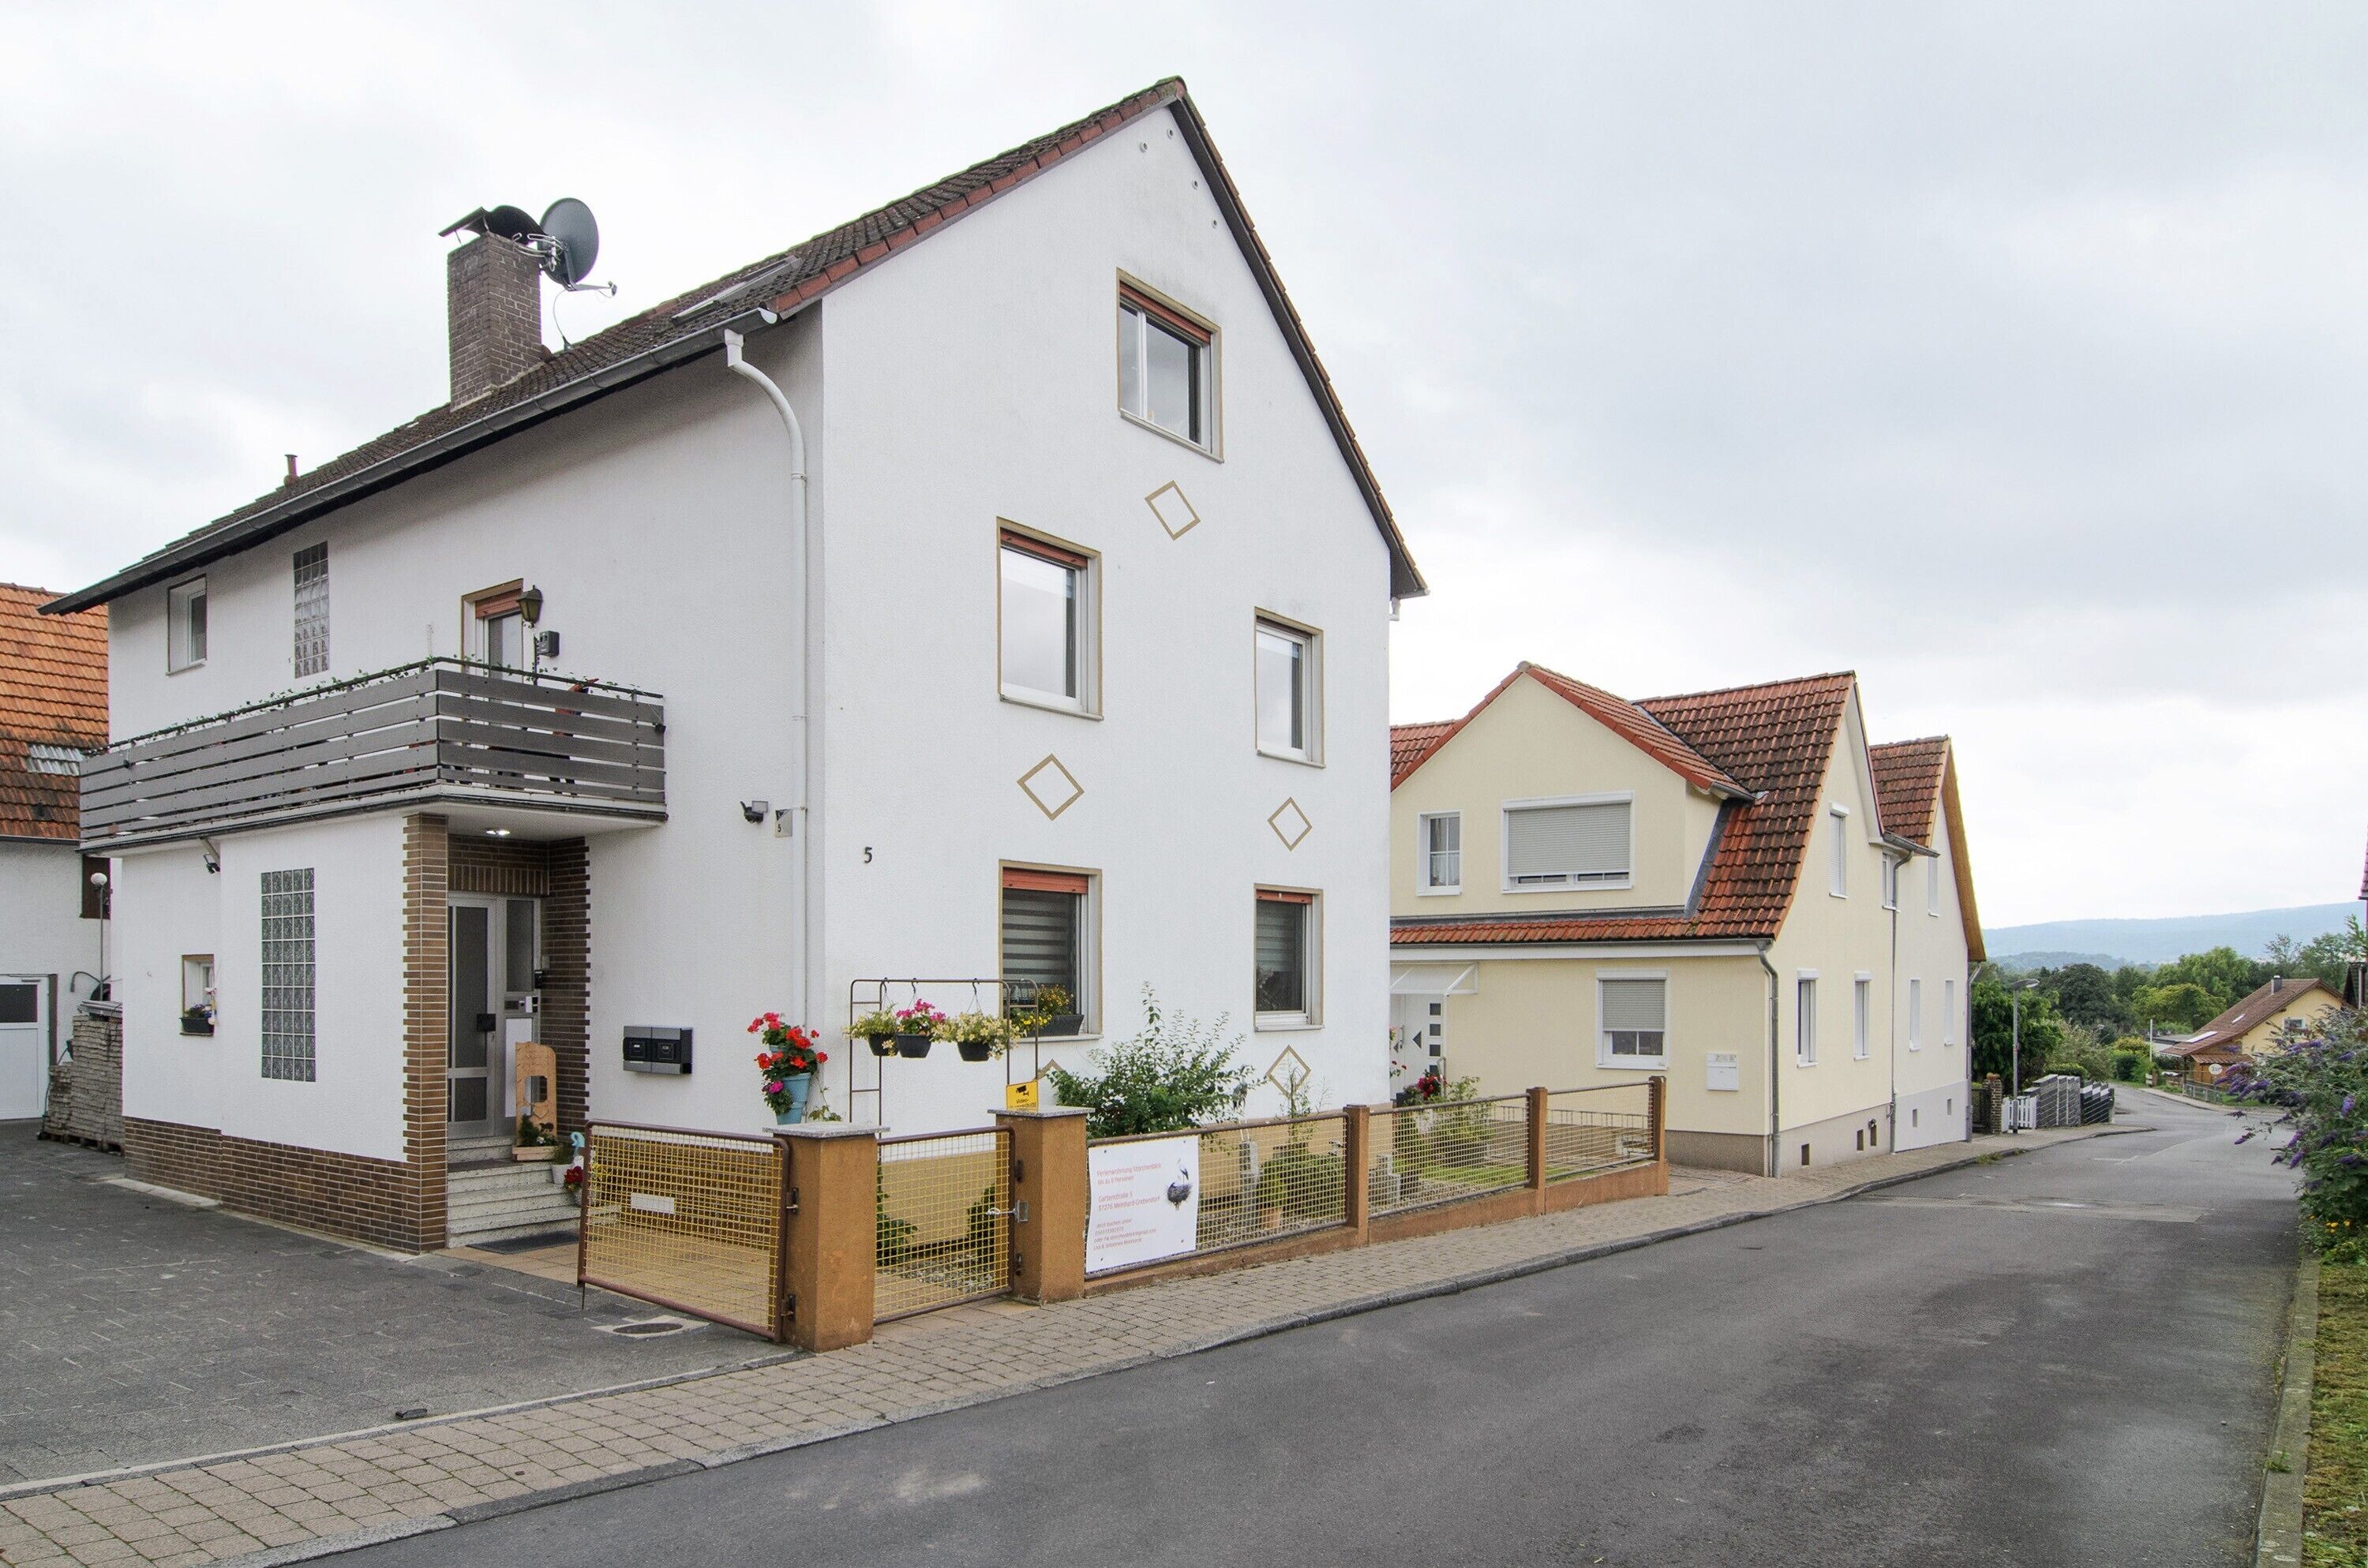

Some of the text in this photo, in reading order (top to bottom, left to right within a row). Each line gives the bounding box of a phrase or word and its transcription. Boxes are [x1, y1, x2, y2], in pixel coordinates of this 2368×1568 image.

[777, 824, 781, 833] 5
[864, 846, 872, 863] 5
[1133, 1163, 1162, 1172] Storchenblick
[1099, 1192, 1129, 1202] Gartenstraße
